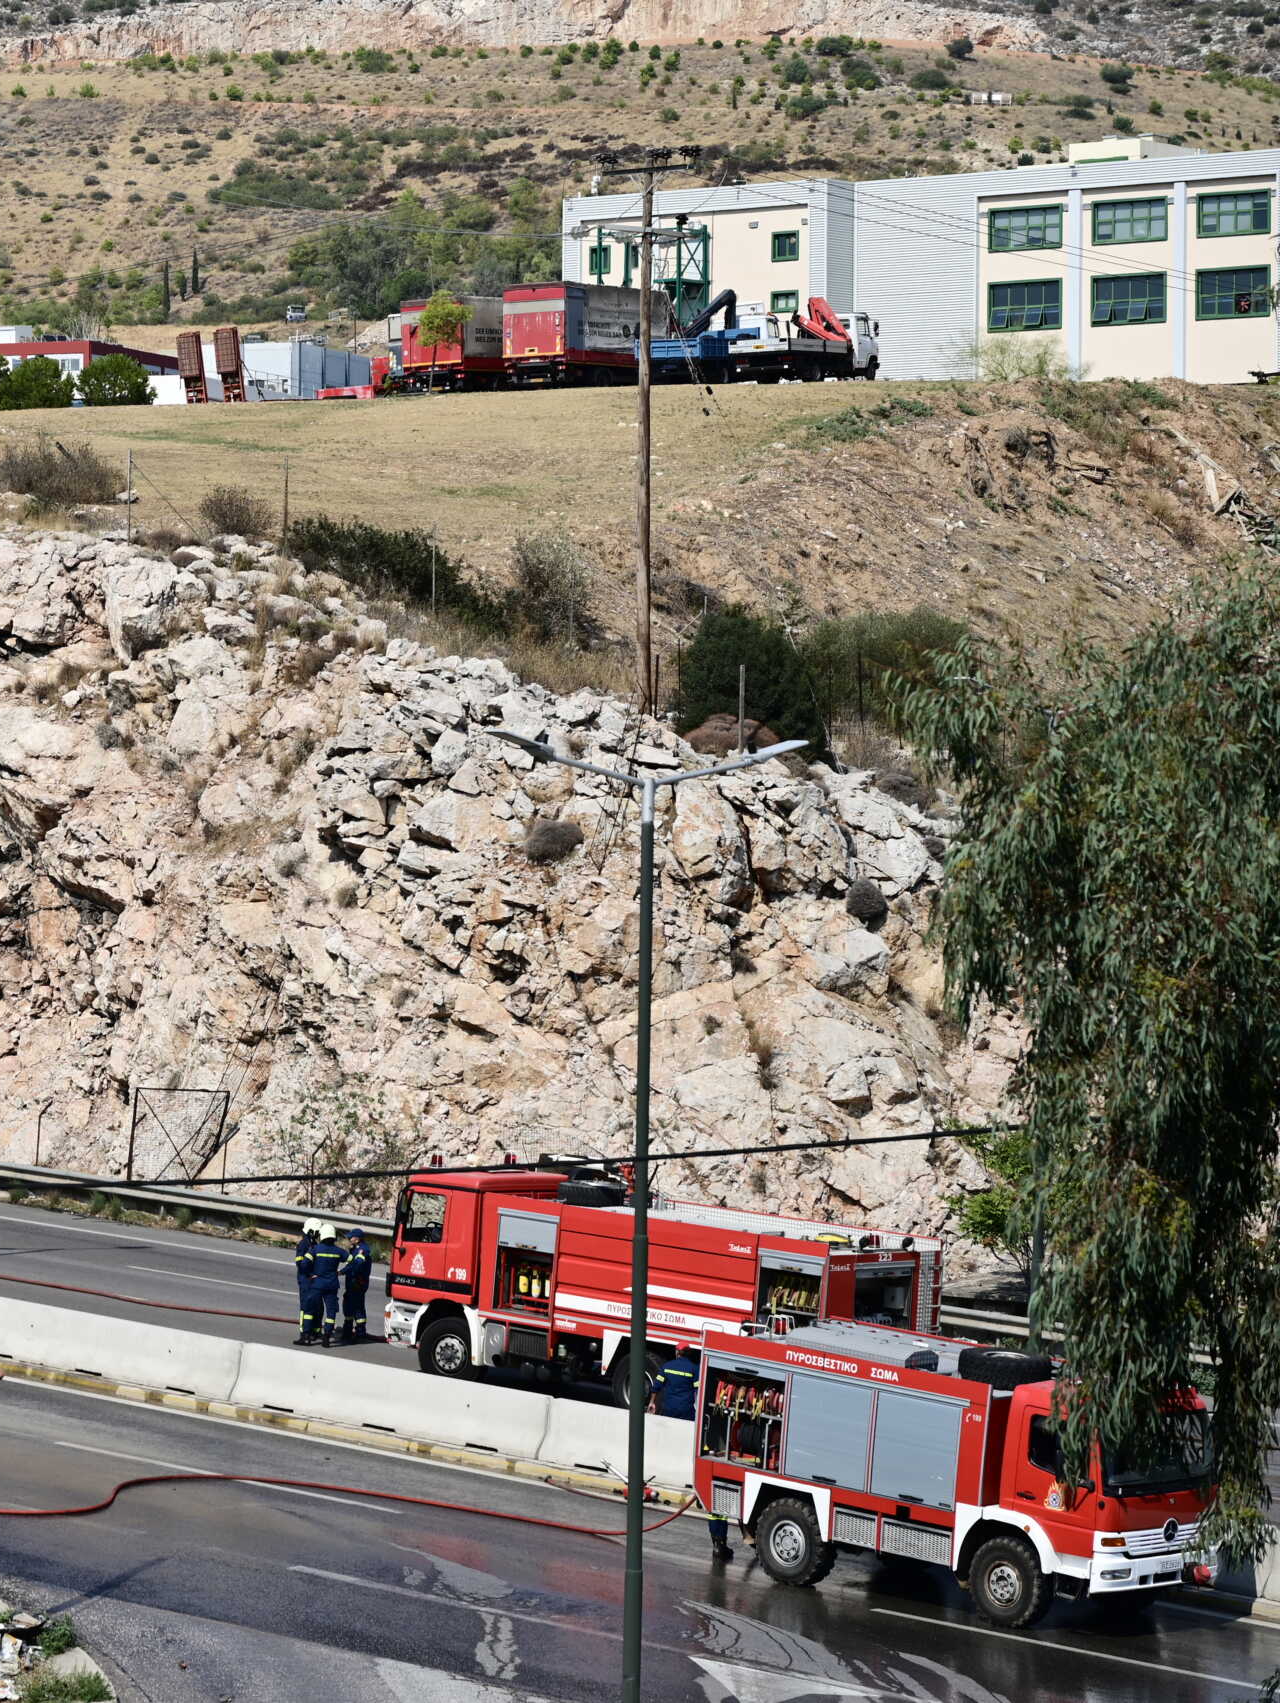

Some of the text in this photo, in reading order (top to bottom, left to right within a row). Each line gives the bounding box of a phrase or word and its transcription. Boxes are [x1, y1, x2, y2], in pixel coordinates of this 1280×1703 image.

[455, 1267, 467, 1281] 199
[664, 1313, 686, 1325] ΣΩΜΑ
[786, 1350, 899, 1382] ΠΥΡΟΣΒΕΣΤΙΚΟ ΣΩΜΑ
